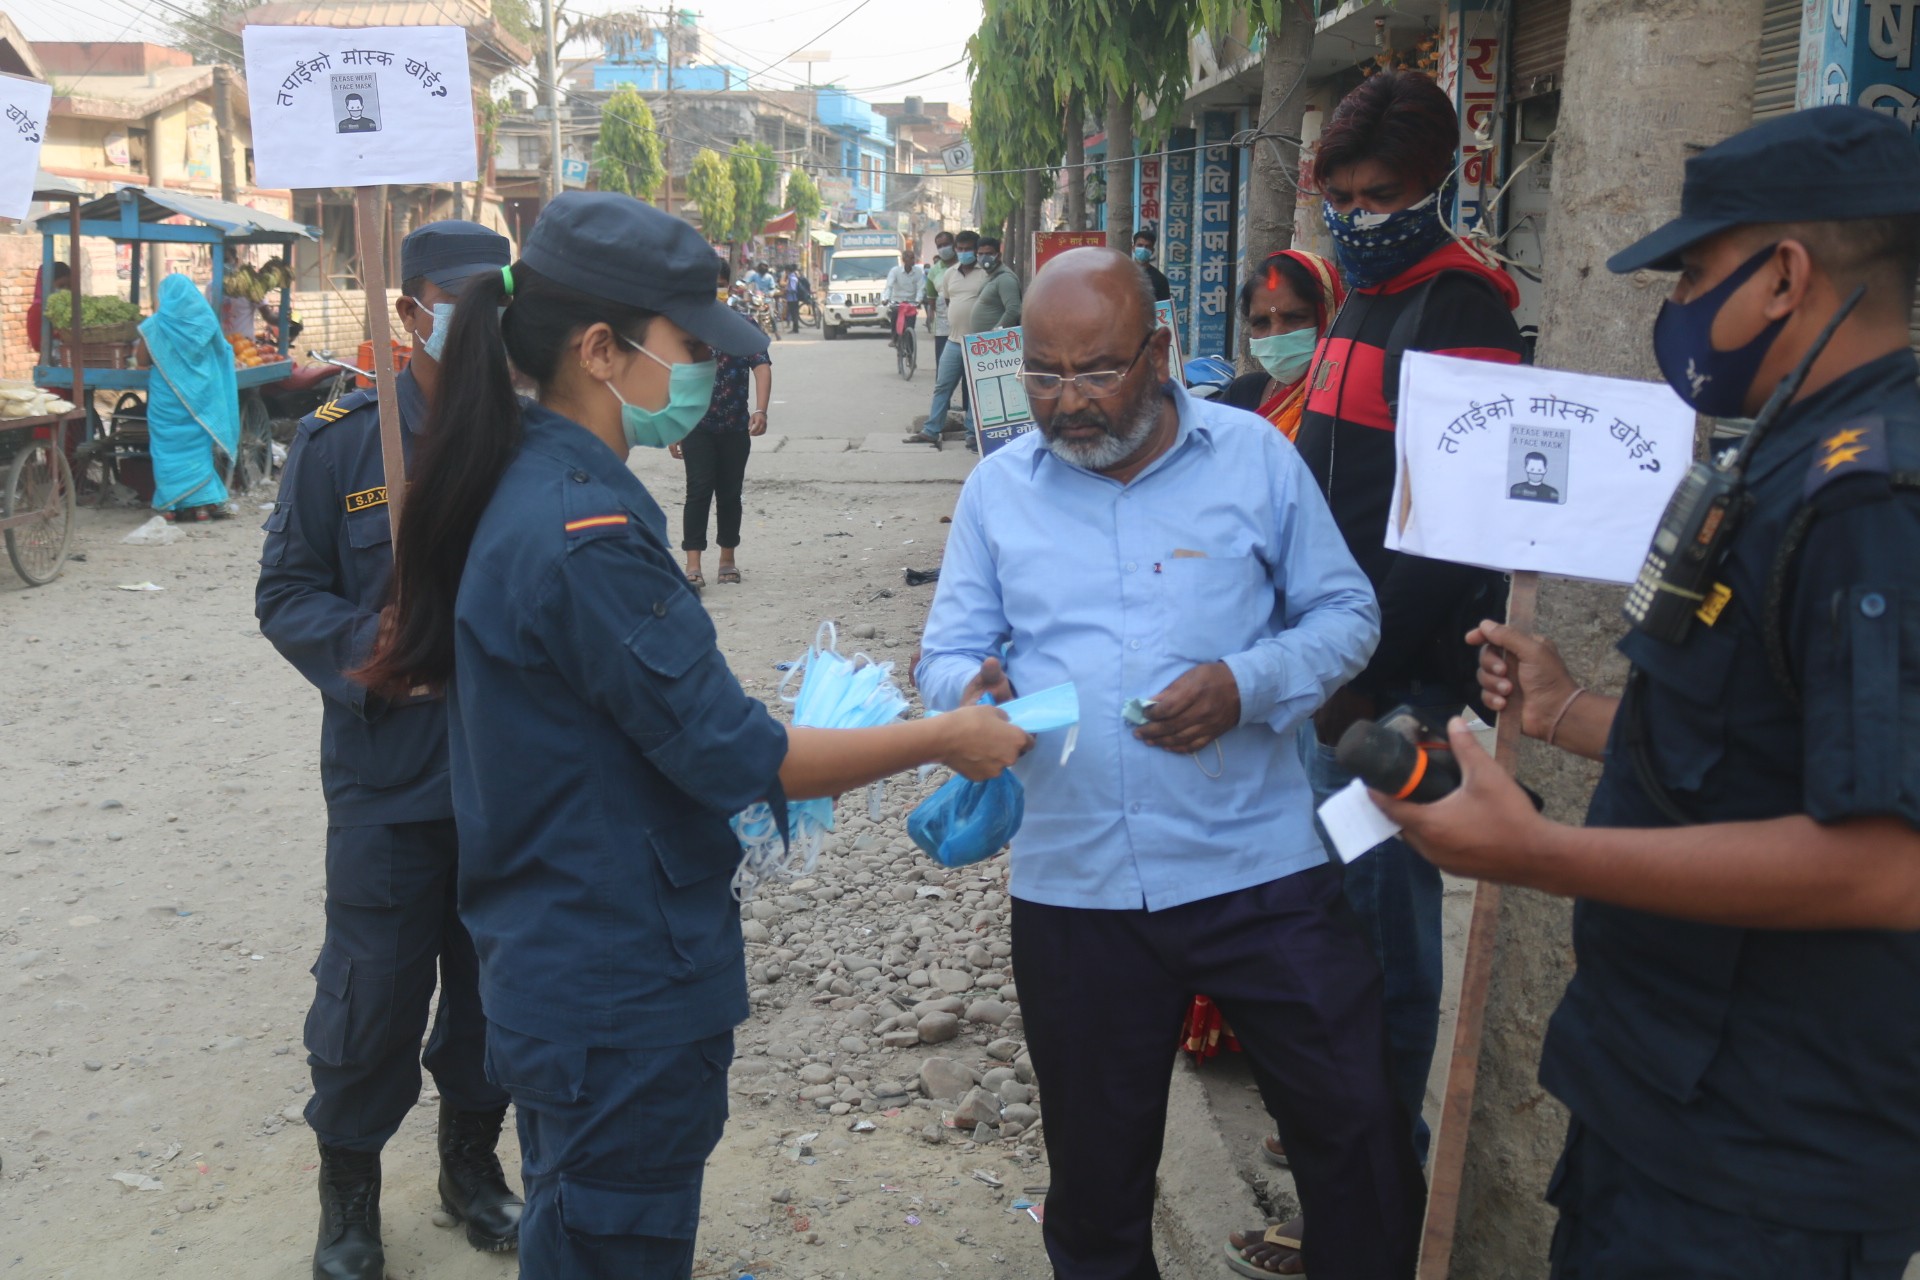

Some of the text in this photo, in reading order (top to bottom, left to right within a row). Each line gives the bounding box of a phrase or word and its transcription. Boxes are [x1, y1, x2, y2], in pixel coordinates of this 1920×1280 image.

[566, 161, 583, 176] P
[969, 330, 1022, 356] केशरी
[977, 357, 1024, 372] Softwe
[1511, 426, 1565, 439] PLEASE WEAR
[1520, 438, 1538, 447] FACE
[1541, 440, 1563, 449] MASK
